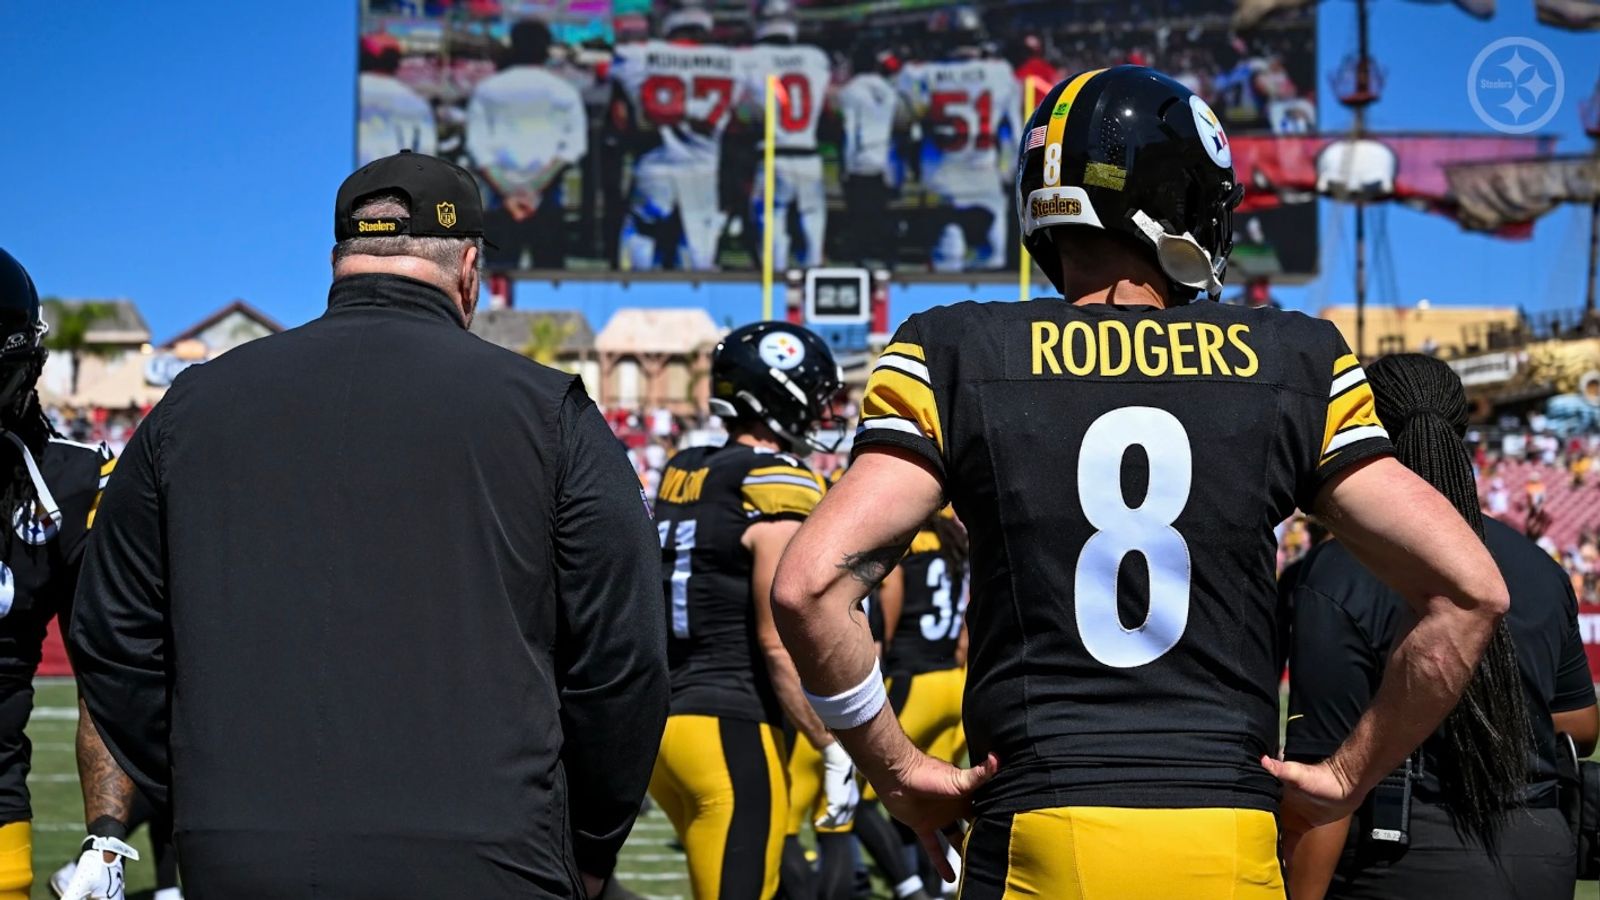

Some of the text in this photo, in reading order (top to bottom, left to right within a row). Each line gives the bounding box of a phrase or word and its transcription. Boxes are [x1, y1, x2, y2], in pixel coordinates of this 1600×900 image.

[1043, 142, 1063, 187] 8
[358, 219, 396, 232] Steelers
[1030, 194, 1082, 220] Steelers
[1031, 319, 1260, 378] RODGERS
[1074, 405, 1193, 669] 8
